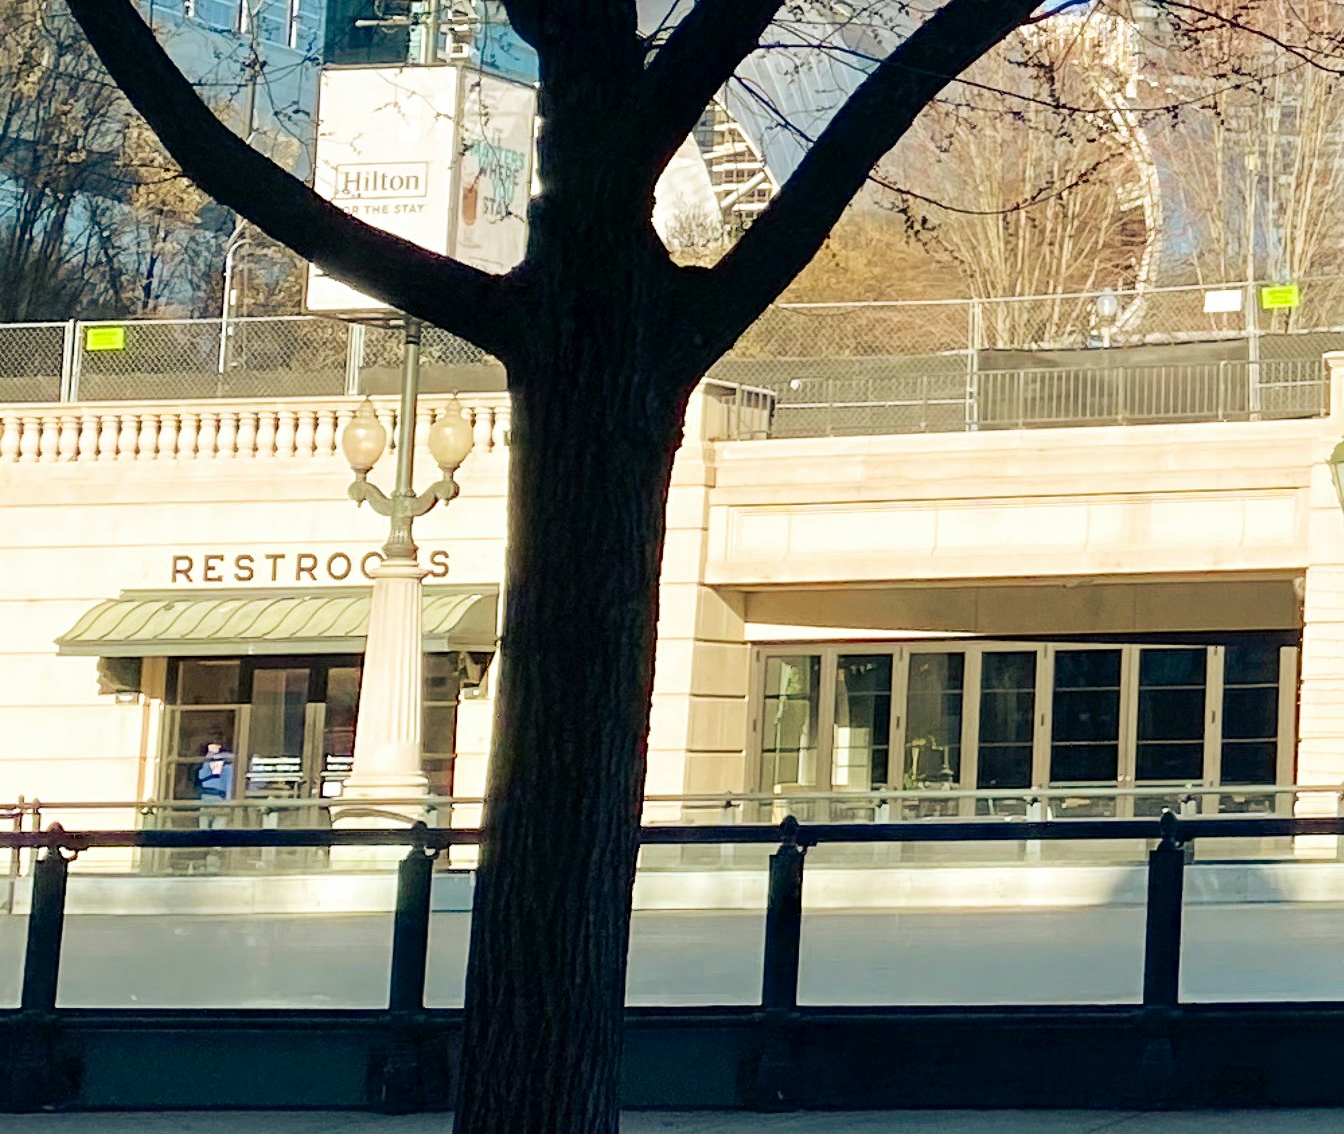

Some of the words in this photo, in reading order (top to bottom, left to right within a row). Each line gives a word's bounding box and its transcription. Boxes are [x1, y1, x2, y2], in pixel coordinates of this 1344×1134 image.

[342, 171, 419, 192] Hilton
[365, 205, 389, 214] THE
[394, 204, 425, 214] STAY
[172, 551, 450, 583] RESTROOS
